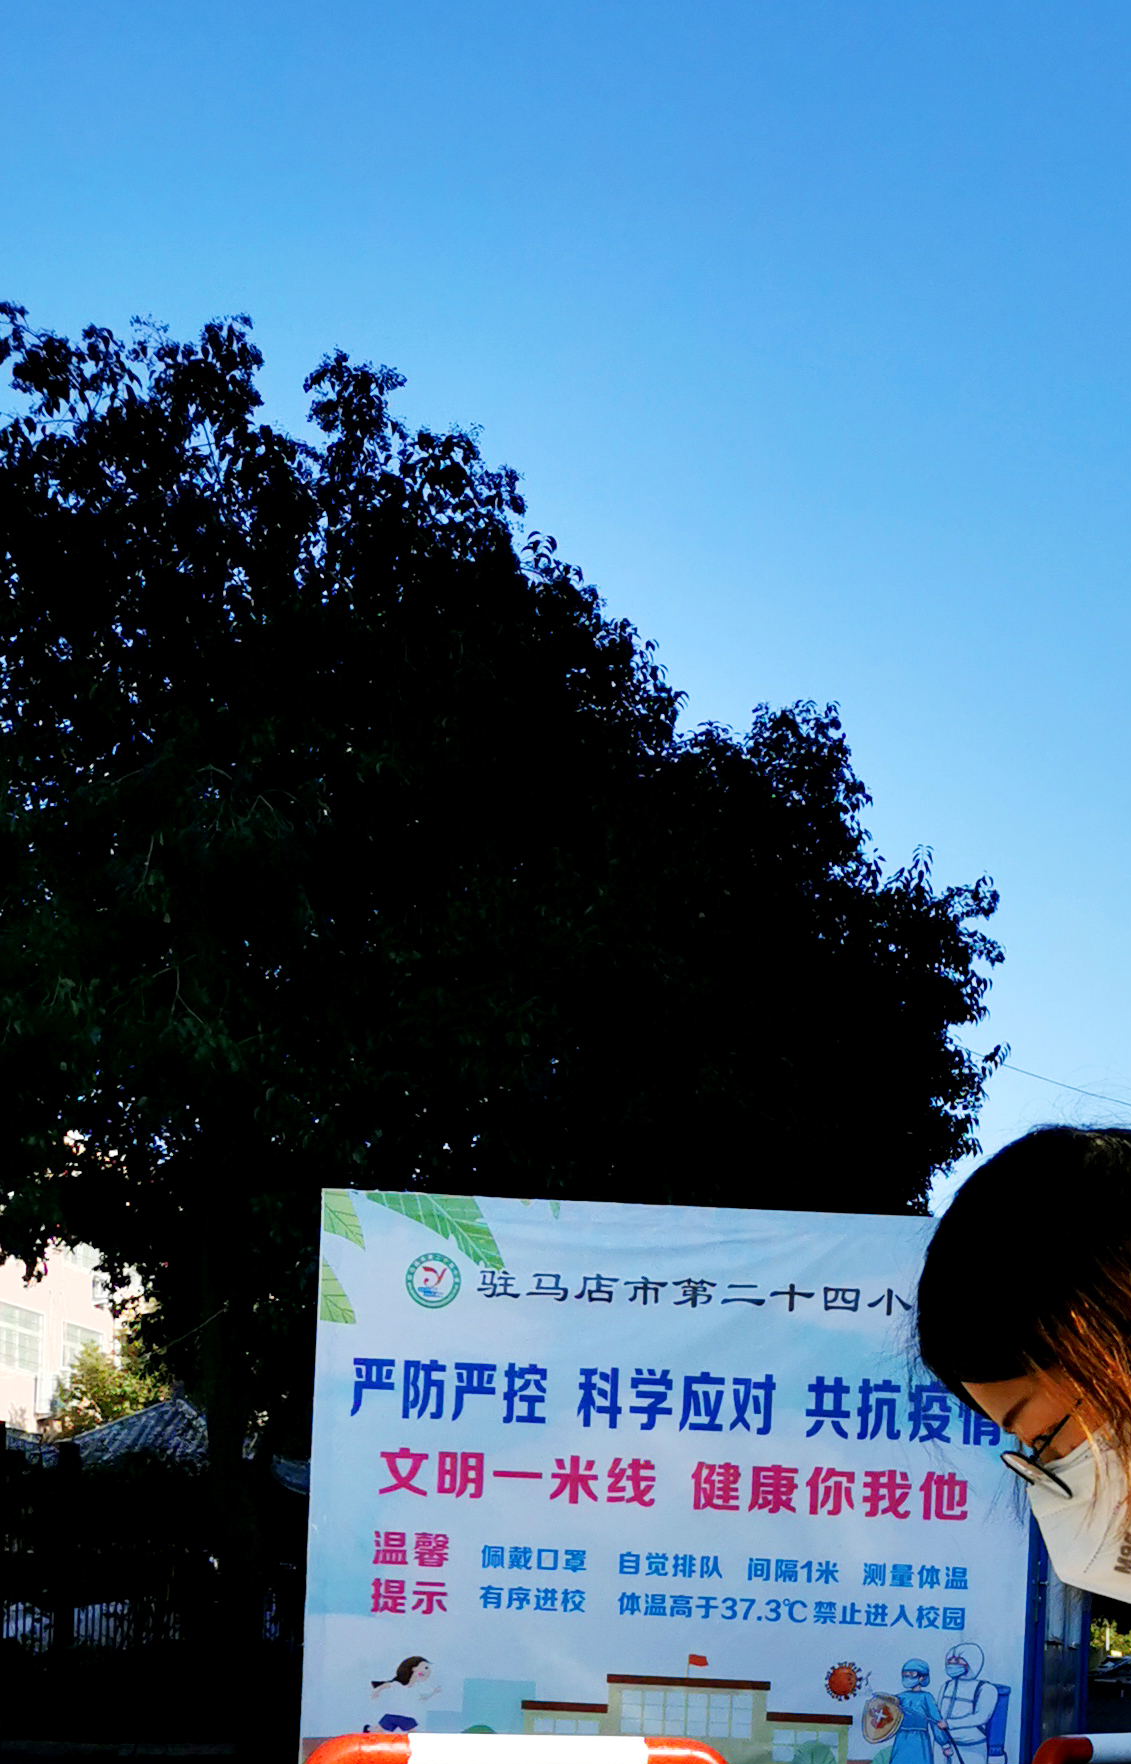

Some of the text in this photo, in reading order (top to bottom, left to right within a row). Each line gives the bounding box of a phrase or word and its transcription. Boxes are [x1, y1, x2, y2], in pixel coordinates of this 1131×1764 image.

[476, 1269, 914, 1317] 驻马店市第二十四小
[350, 1357, 1001, 1446] 严防严控 科学应对 共抗疫情
[378, 1447, 969, 1521] 文明一米线 健康你我他
[372, 1530, 450, 1568] 温馨
[481, 1544, 969, 1590] 佩戴口罩 自觉排队 间隔1米 测量体温
[370, 1577, 449, 1615] 提示
[479, 1584, 586, 1613] 有序进校
[813, 1600, 966, 1631] 禁止进入校园
